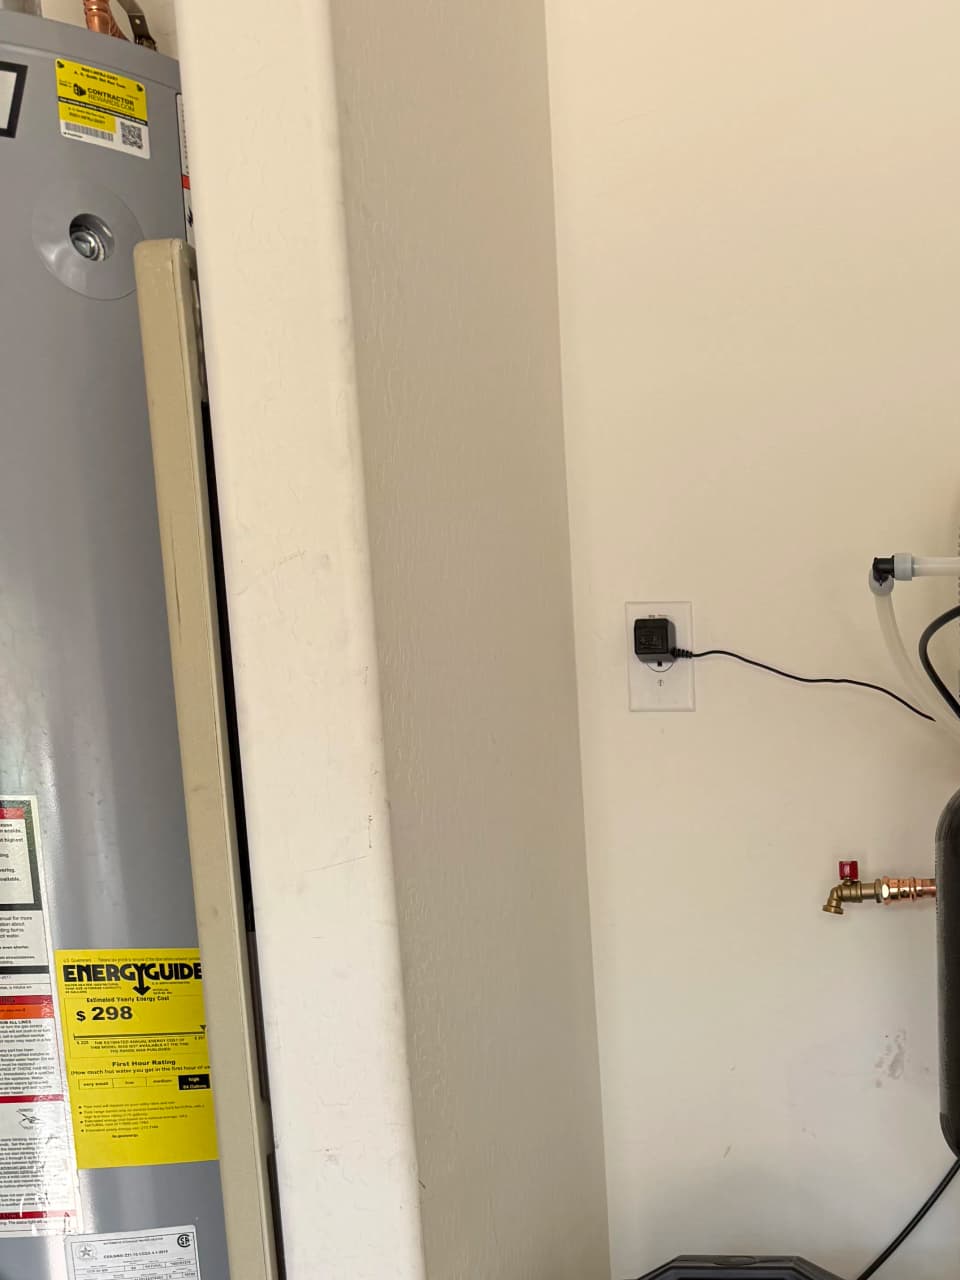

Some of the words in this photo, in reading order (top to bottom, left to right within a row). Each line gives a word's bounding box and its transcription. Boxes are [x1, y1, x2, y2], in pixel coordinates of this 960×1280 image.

[88, 88, 134, 106] CONTRACTOR
[63, 963, 203, 984] ENERGYGUIDE
[76, 1010, 86, 1022] $
[91, 1006, 133, 1021] 298
